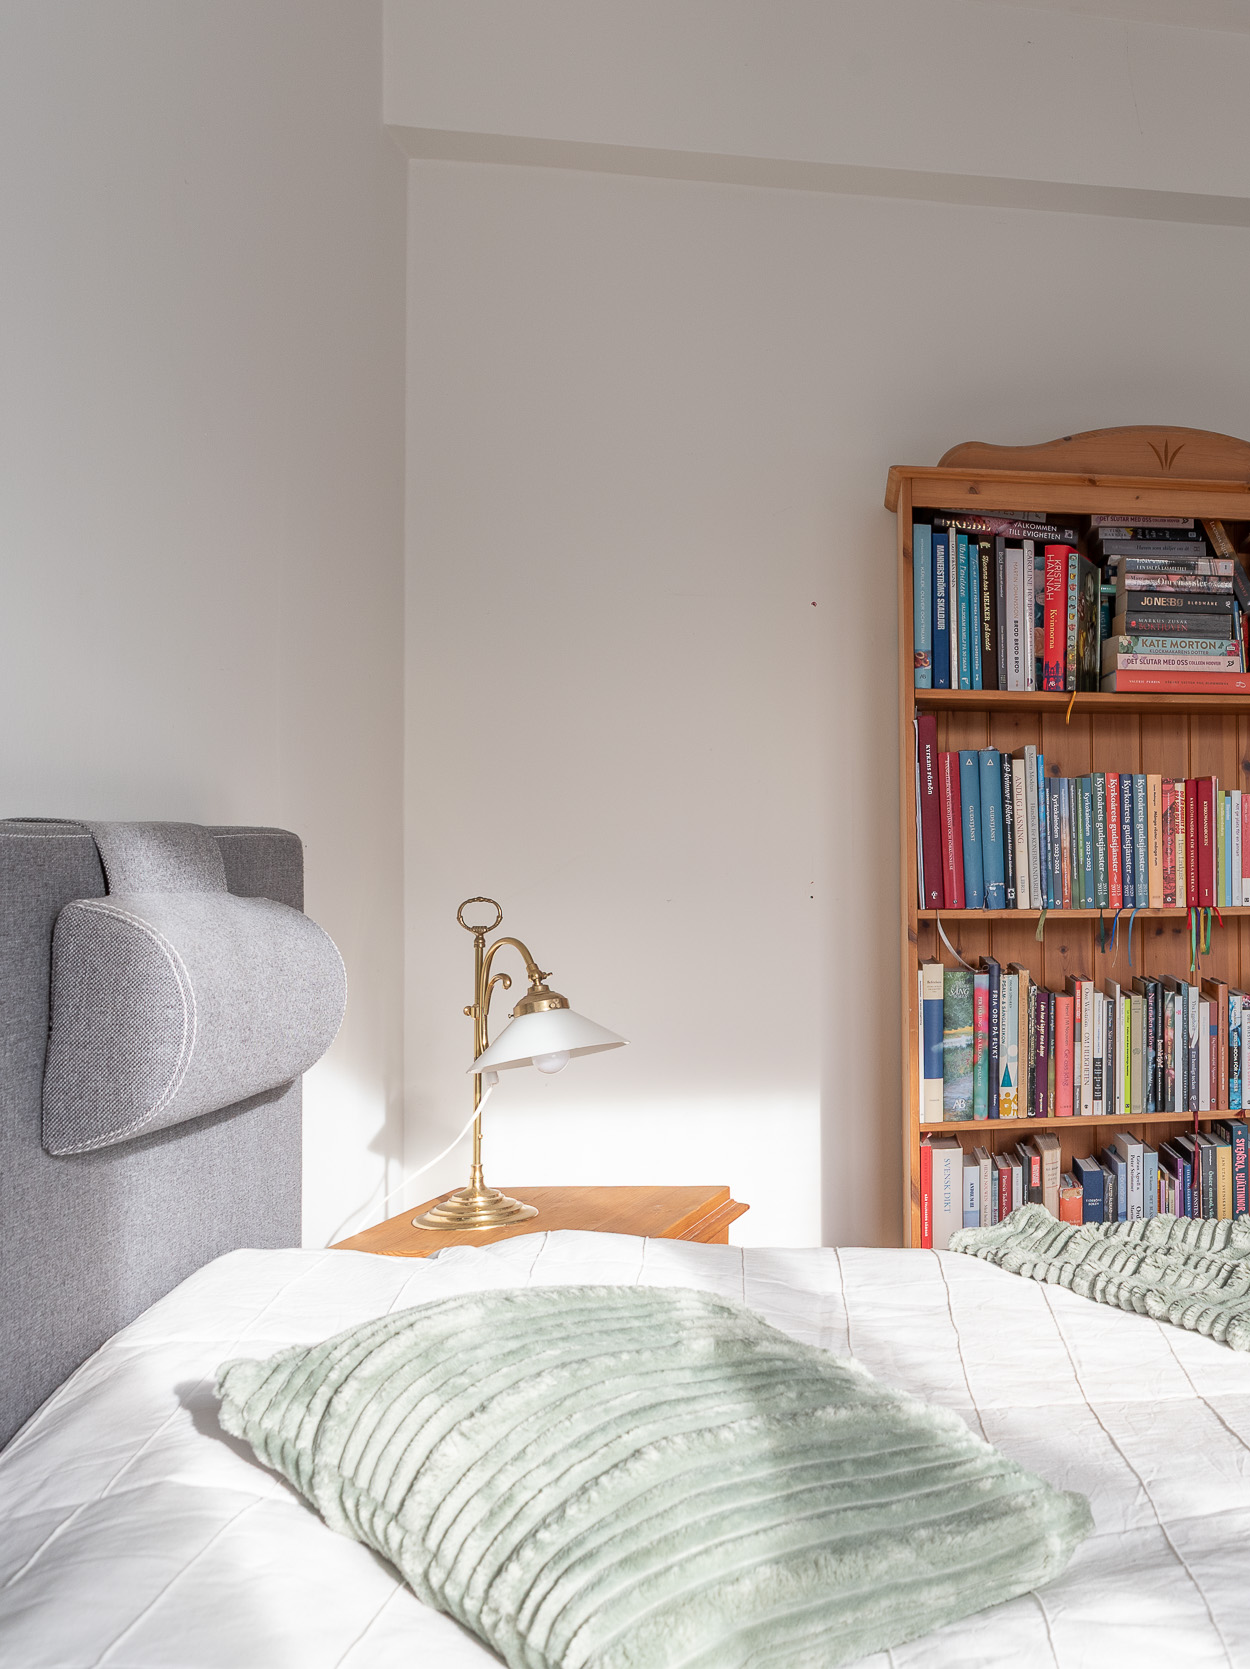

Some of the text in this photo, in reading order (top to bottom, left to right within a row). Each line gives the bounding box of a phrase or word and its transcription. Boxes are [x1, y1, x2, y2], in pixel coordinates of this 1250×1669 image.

[1014, 522, 1057, 532] VÄLKOMMEN
[1023, 531, 1061, 540] EVIGHETEN
[937, 545, 945, 630] MANNERSTRÖMS SKALDJUR
[1046, 554, 1057, 649] HANNAH Kvinnorna
[1154, 597, 1183, 606] NESBØ
[983, 623, 990, 631] på
[1139, 623, 1188, 631] BOKTJUVEN
[1142, 639, 1216, 649] KATE MORTON
[1004, 773, 1013, 825] kvinnor Bibeln
[1180, 790, 1184, 798] DU
[1016, 808, 1024, 844] LÄSNING
[1094, 778, 1105, 871] Kyrkoårets gudstjänster
[1107, 779, 1119, 872] Kyrkoårets gudstjänster
[1122, 780, 1133, 873] Kyrkoårets gudstjänster
[1135, 779, 1146, 872] Kyrkoårets gudstjänster
[1032, 837, 1040, 901] KONFIRMANDARBETE
[992, 1026, 999, 1035] PÅ
[1084, 1032, 1090, 1043] OM
[1062, 1072, 1070, 1087] idag
[952, 1099, 966, 1110] AB
[1235, 1138, 1247, 1171] SVENSKA
[943, 1158, 951, 1190] SVENSK
